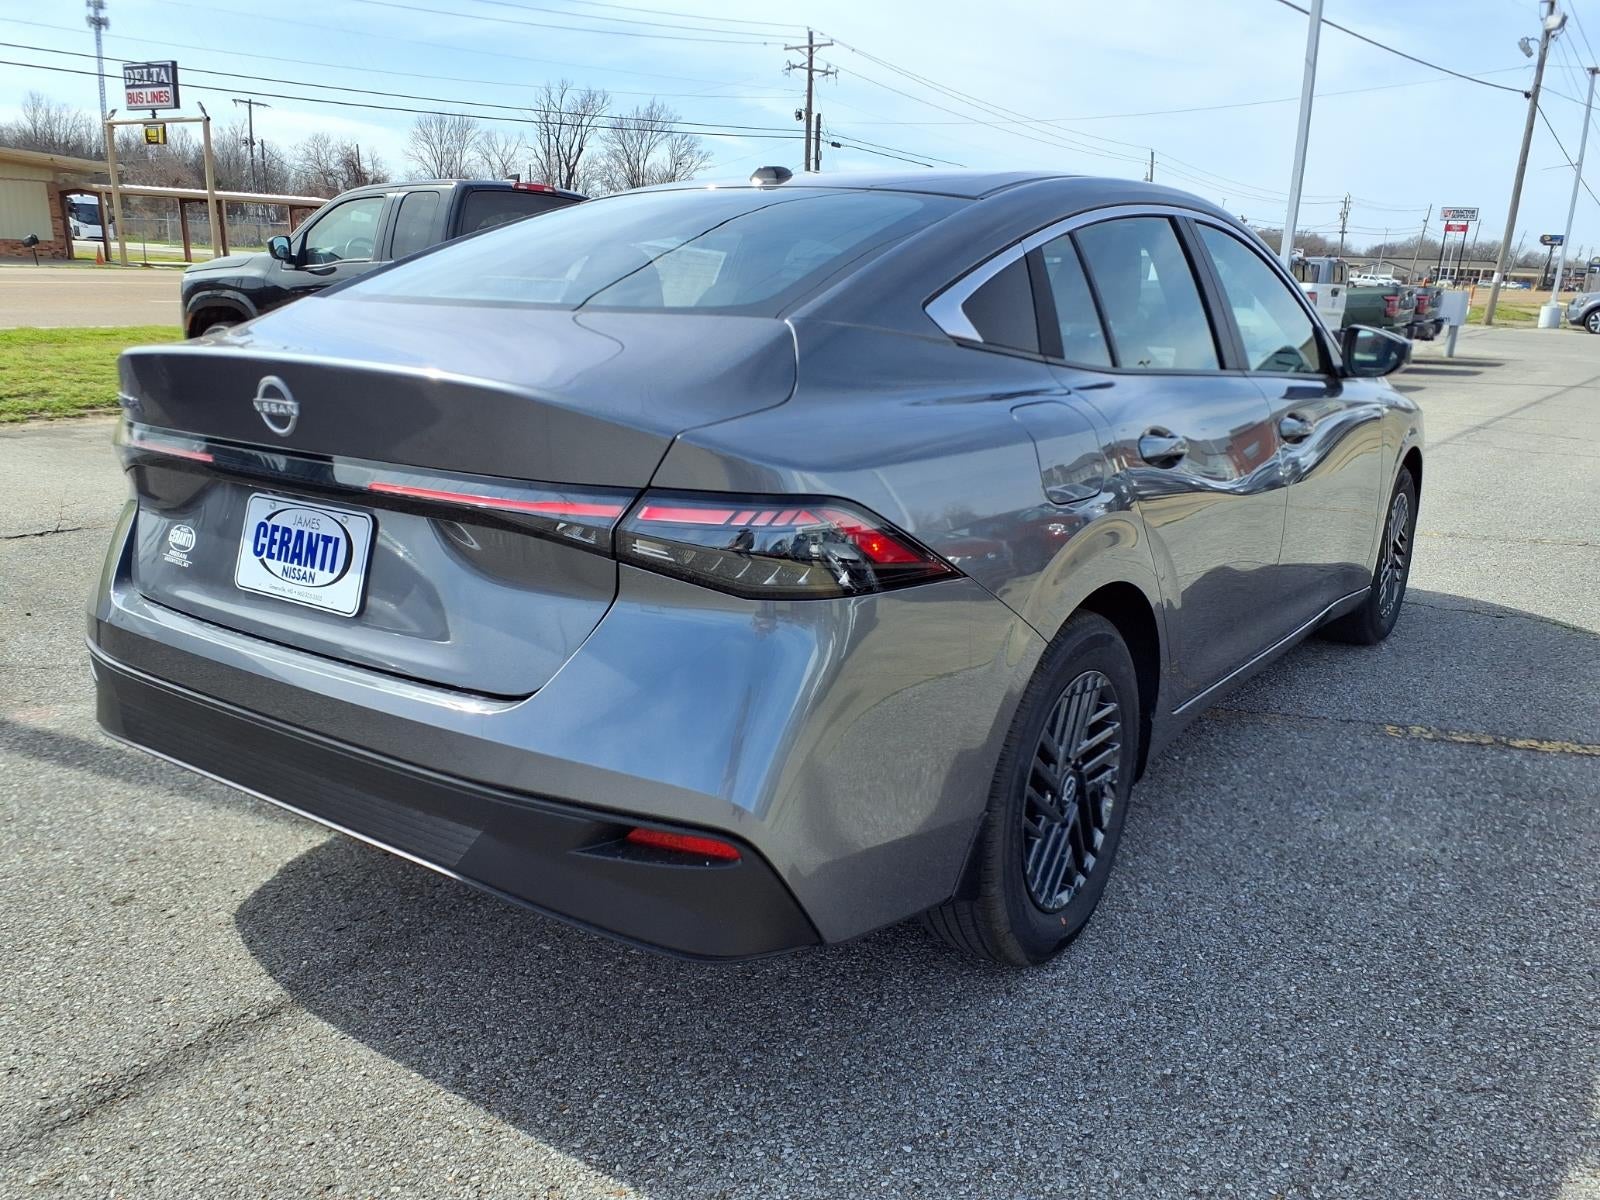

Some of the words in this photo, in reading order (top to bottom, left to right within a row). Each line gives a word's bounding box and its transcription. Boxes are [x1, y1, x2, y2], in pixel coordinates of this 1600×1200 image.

[124, 68, 169, 86] DELTA
[127, 91, 144, 105] BUS
[145, 90, 170, 104] LINES
[253, 399, 299, 416] NISSAN
[293, 514, 321, 531] JAMES
[169, 529, 193, 548] CERANTI
[253, 521, 340, 574] CERANTI
[281, 565, 316, 585] NISSAN
